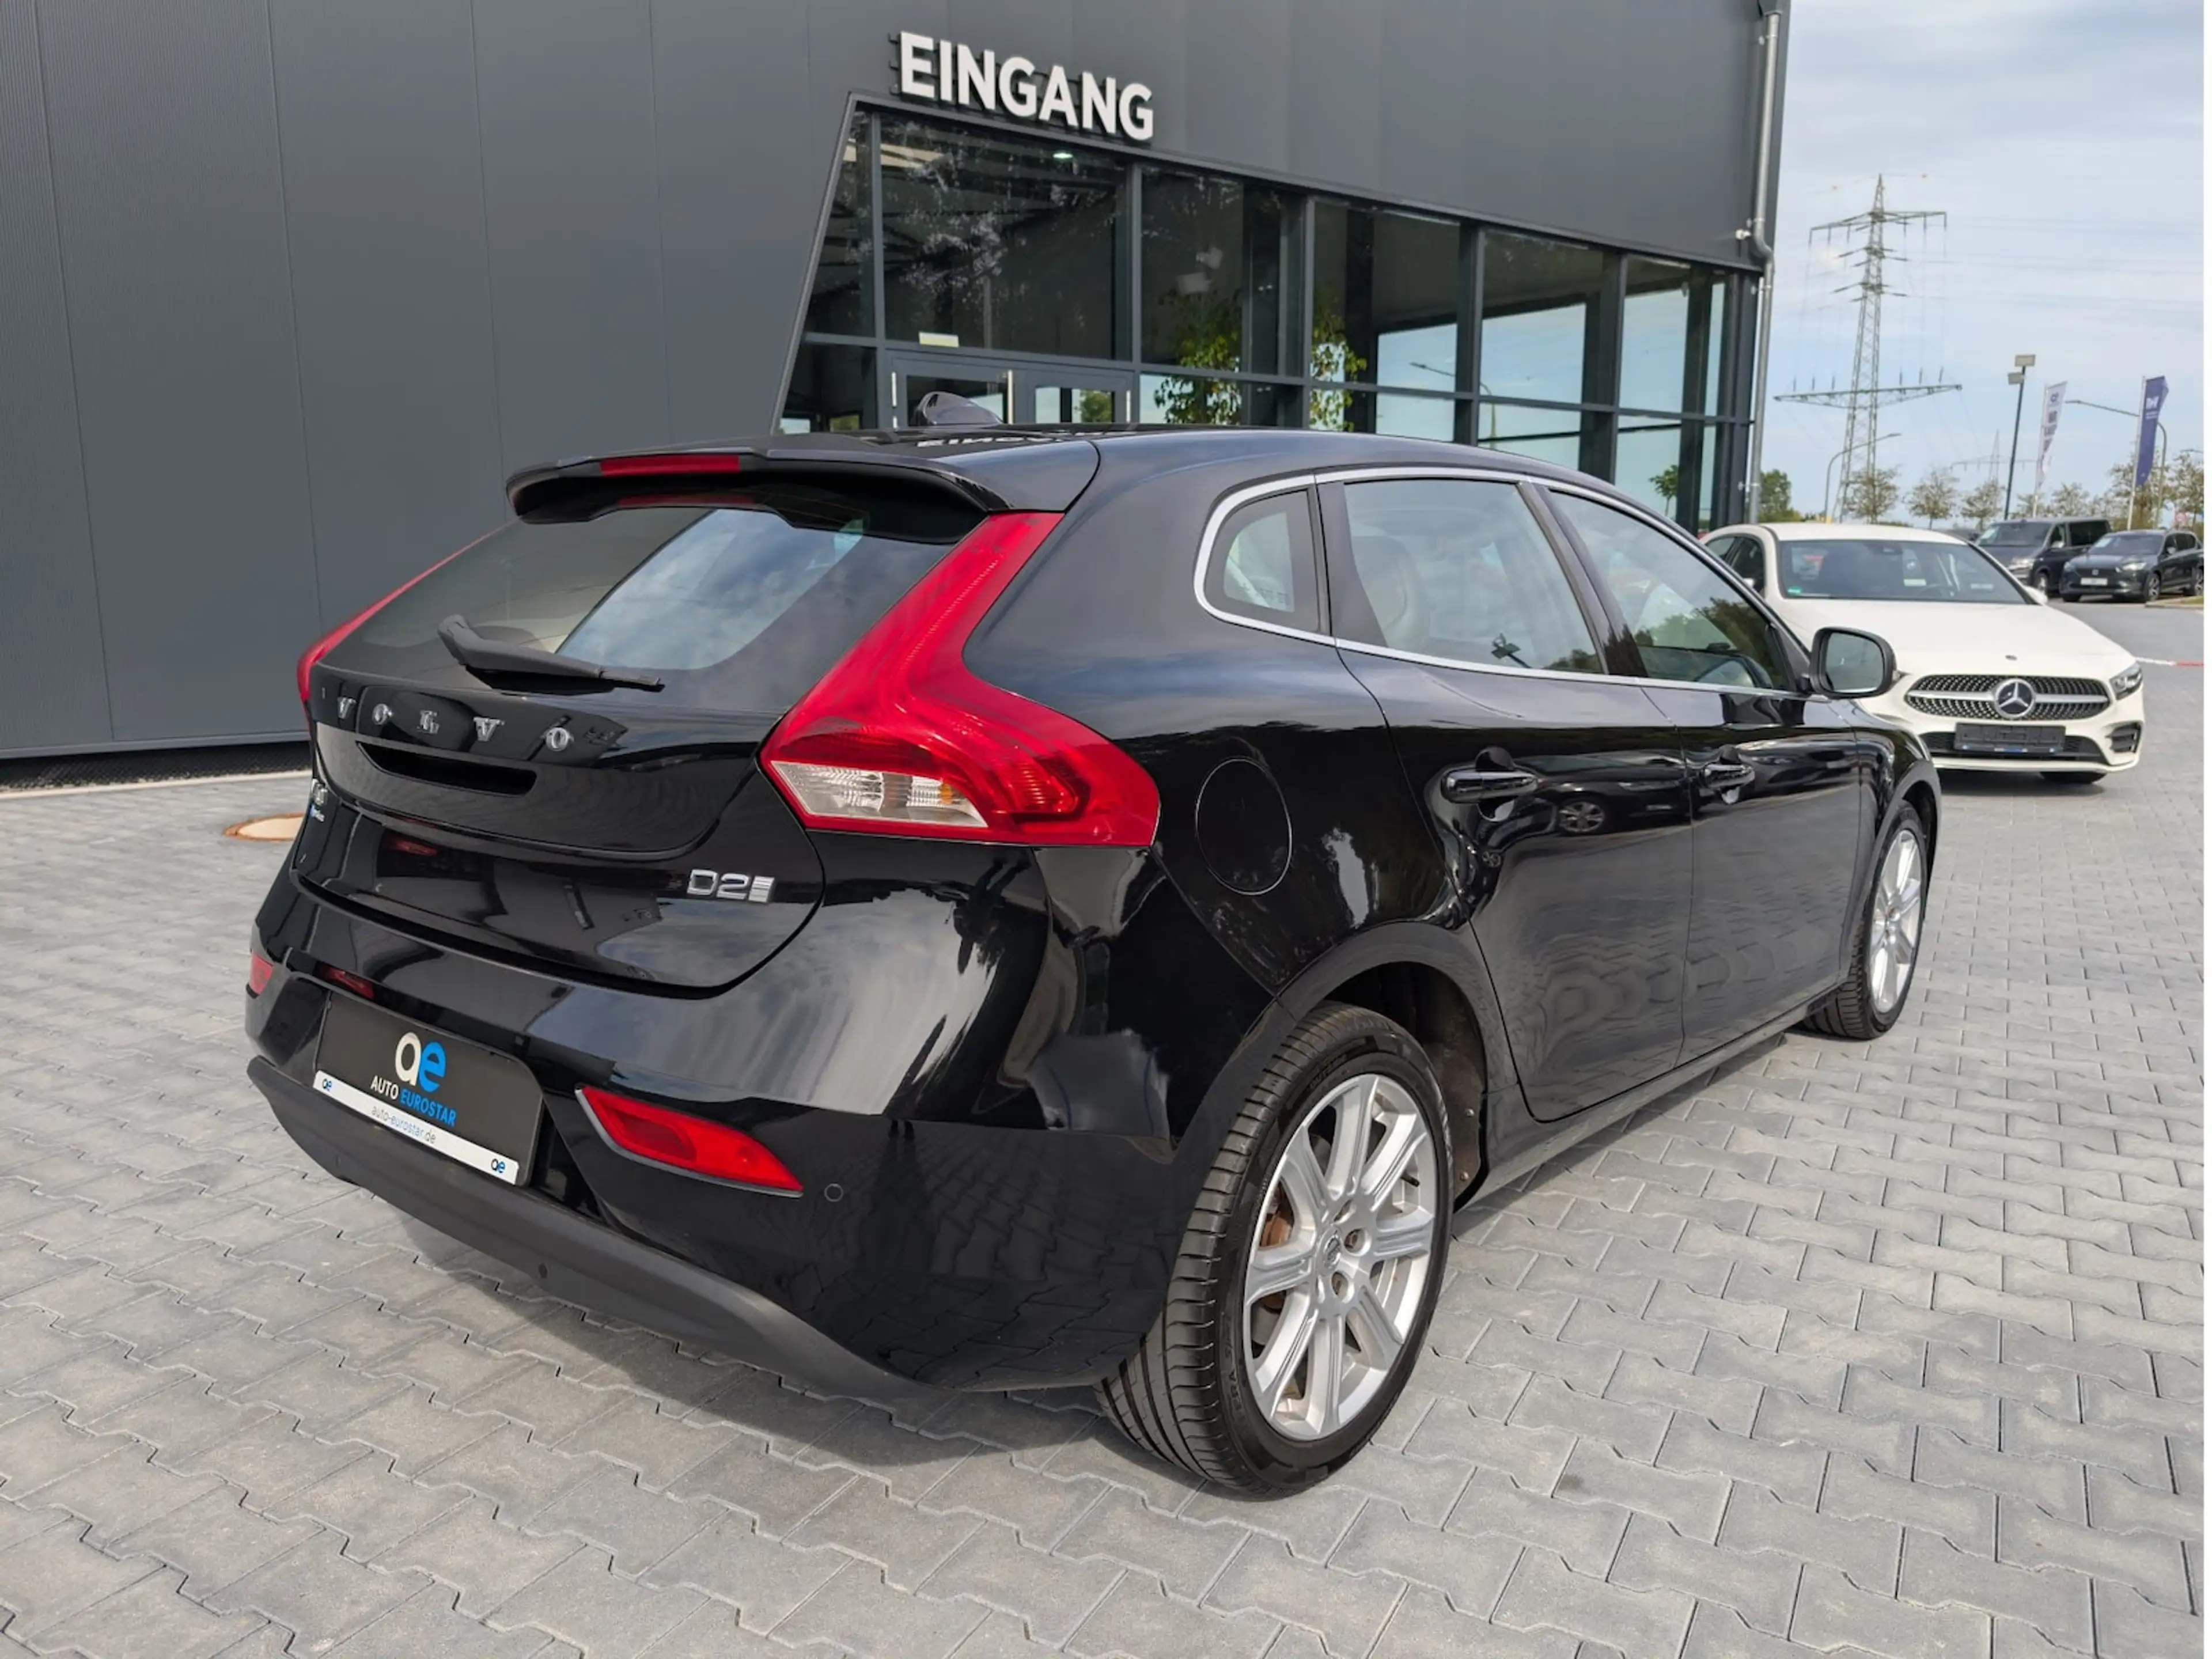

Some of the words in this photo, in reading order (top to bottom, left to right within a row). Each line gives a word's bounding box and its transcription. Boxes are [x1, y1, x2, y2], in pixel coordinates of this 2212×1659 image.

[900, 31, 1153, 141] EINGANG
[338, 696, 574, 751] VOLVO
[687, 869, 751, 900] D2
[395, 1032, 446, 1093] ae
[370, 1075, 399, 1100] AUTO
[400, 1088, 457, 1127] EUROSTAR
[371, 1106, 437, 1145] auto-eurostar.de
